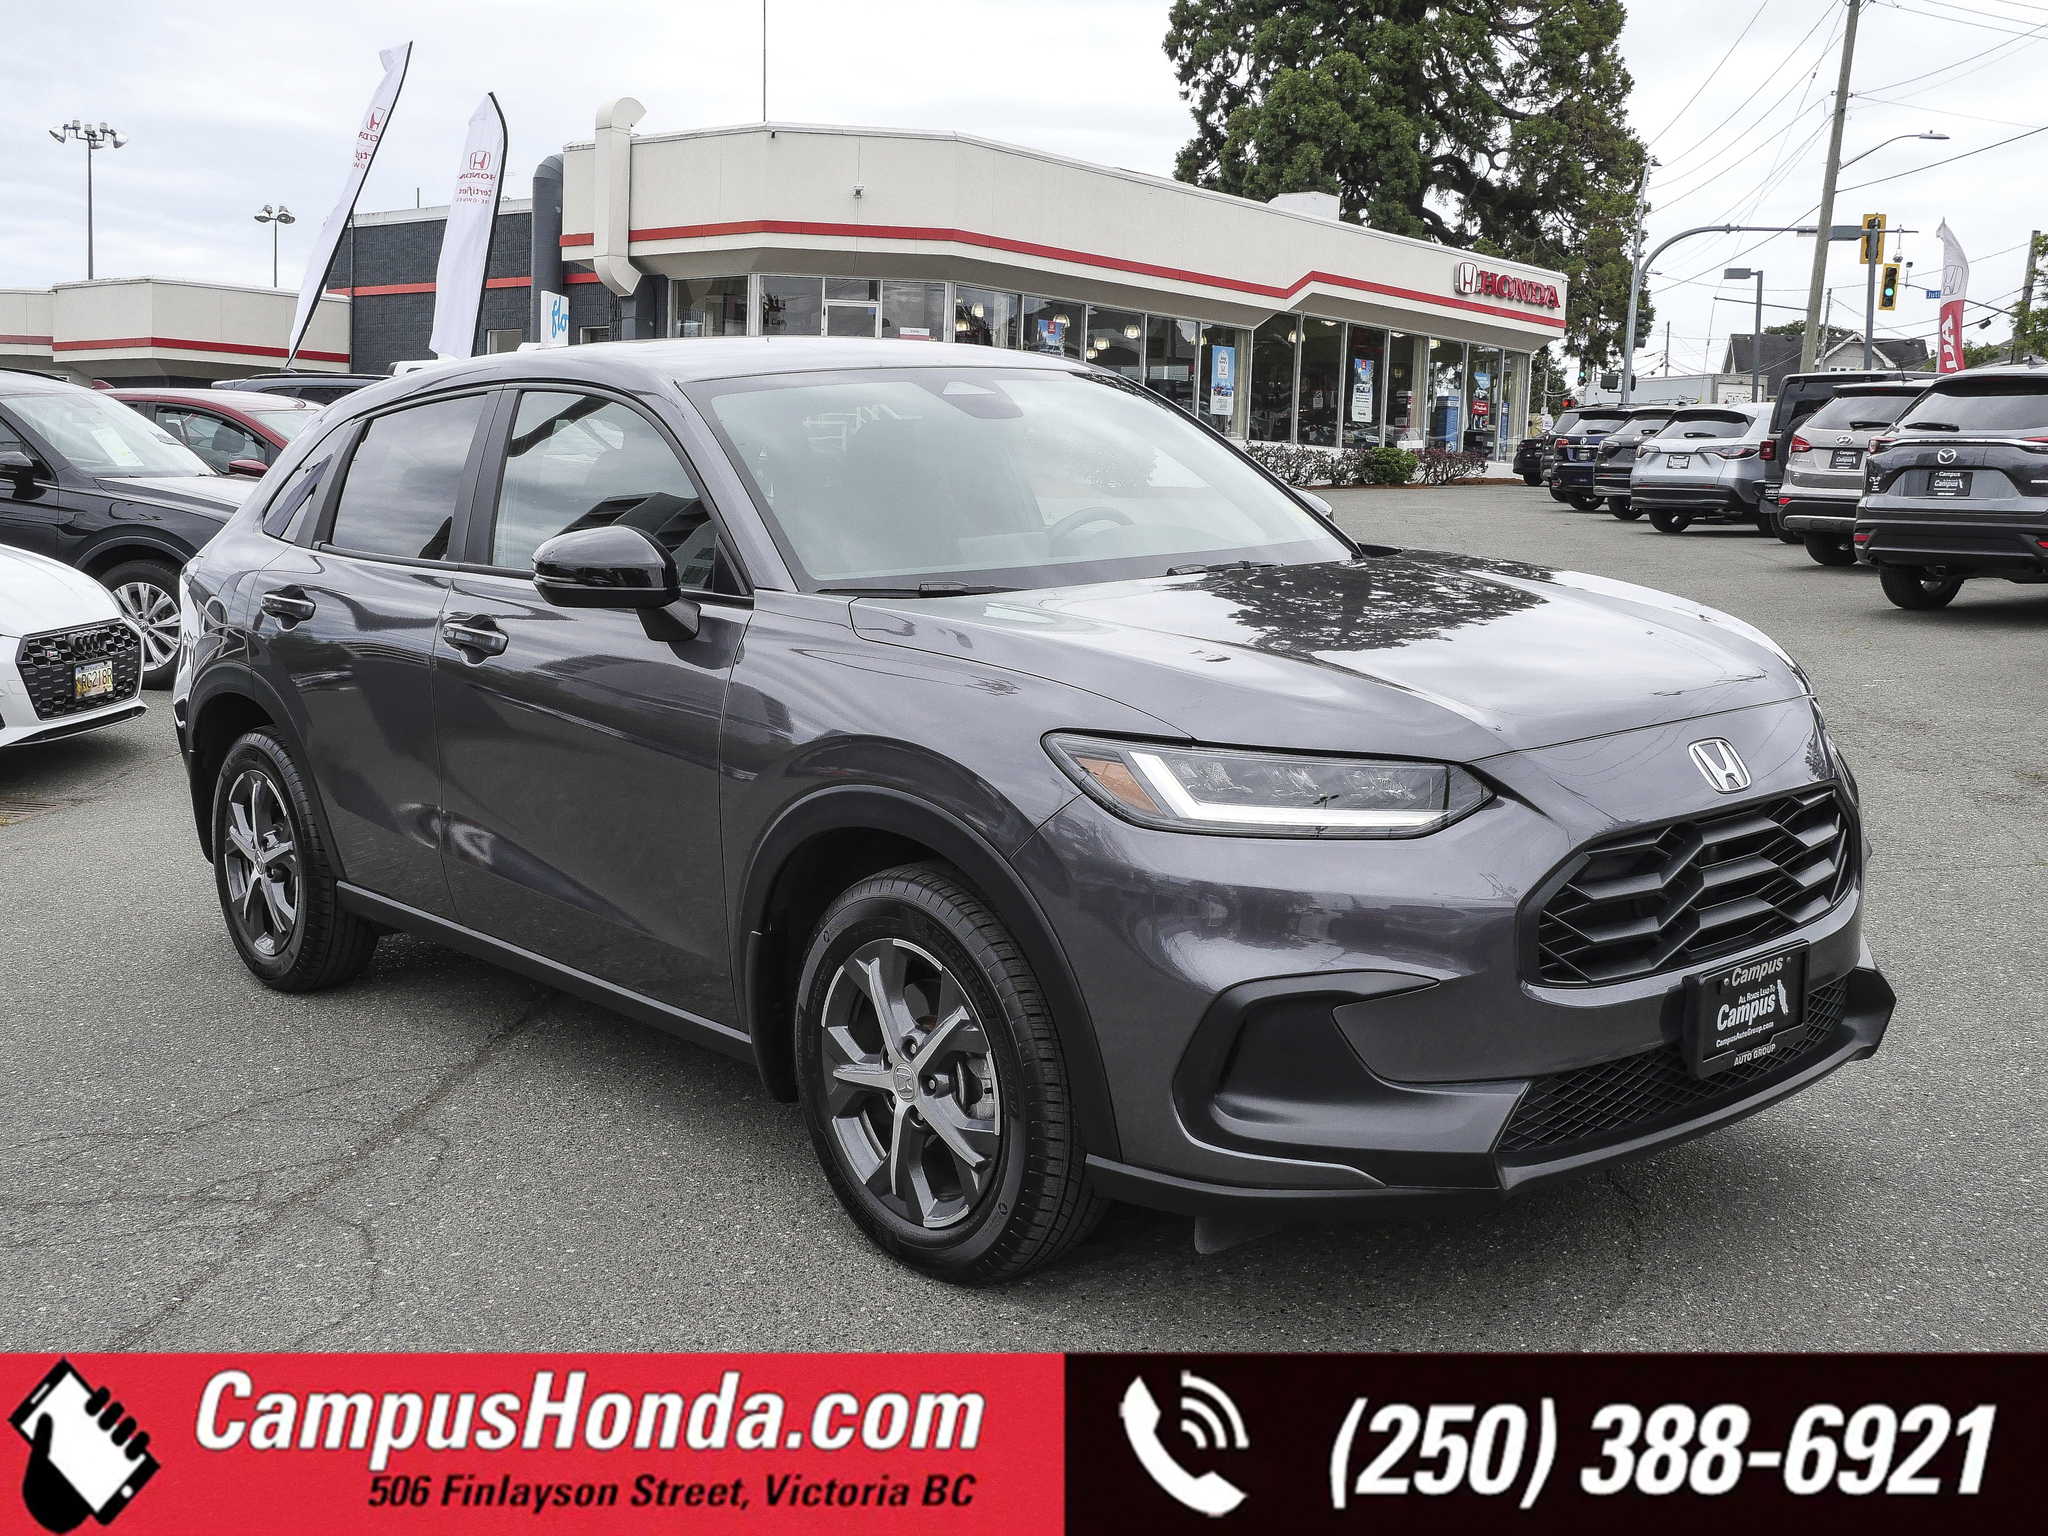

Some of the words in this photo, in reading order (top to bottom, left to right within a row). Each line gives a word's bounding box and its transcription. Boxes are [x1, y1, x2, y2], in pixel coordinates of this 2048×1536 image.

[1478, 270, 1561, 309] HONDA
[551, 295, 569, 338] flo
[1934, 479, 1959, 488] Campus
[1731, 957, 1783, 987] Campus
[1717, 994, 1776, 1031] Campus
[1716, 1021, 1774, 1048] CampusAutoGroup.com
[1733, 1051, 1752, 1066] AUTO
[1753, 1043, 1776, 1058] GROUP
